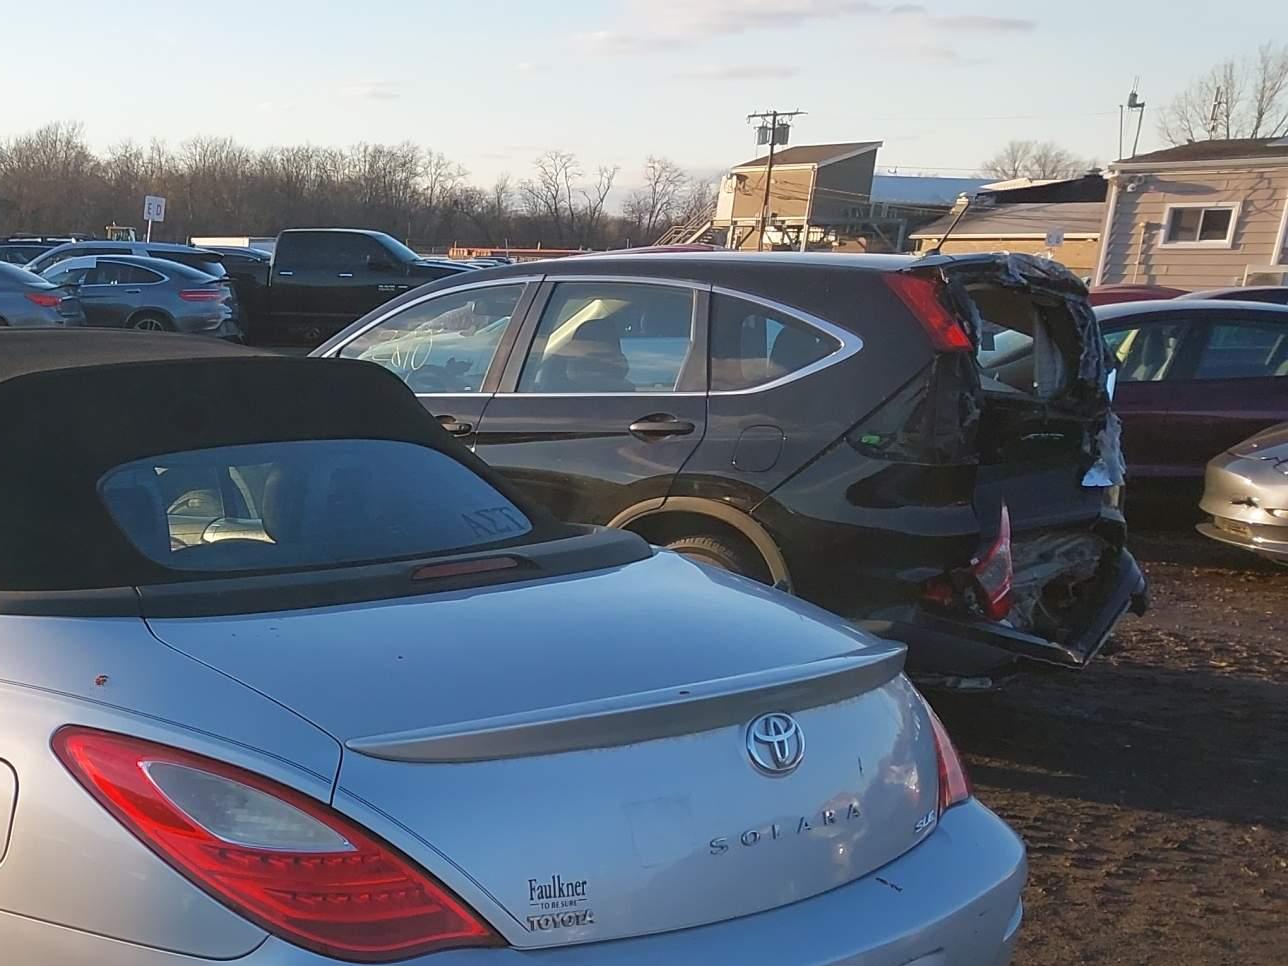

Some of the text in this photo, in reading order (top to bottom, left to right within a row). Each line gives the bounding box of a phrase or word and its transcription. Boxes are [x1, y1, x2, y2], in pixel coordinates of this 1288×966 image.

[709, 803, 862, 855] SOLARA
[528, 874, 587, 901] Faulkner
[527, 909, 595, 931] TOYOTA
